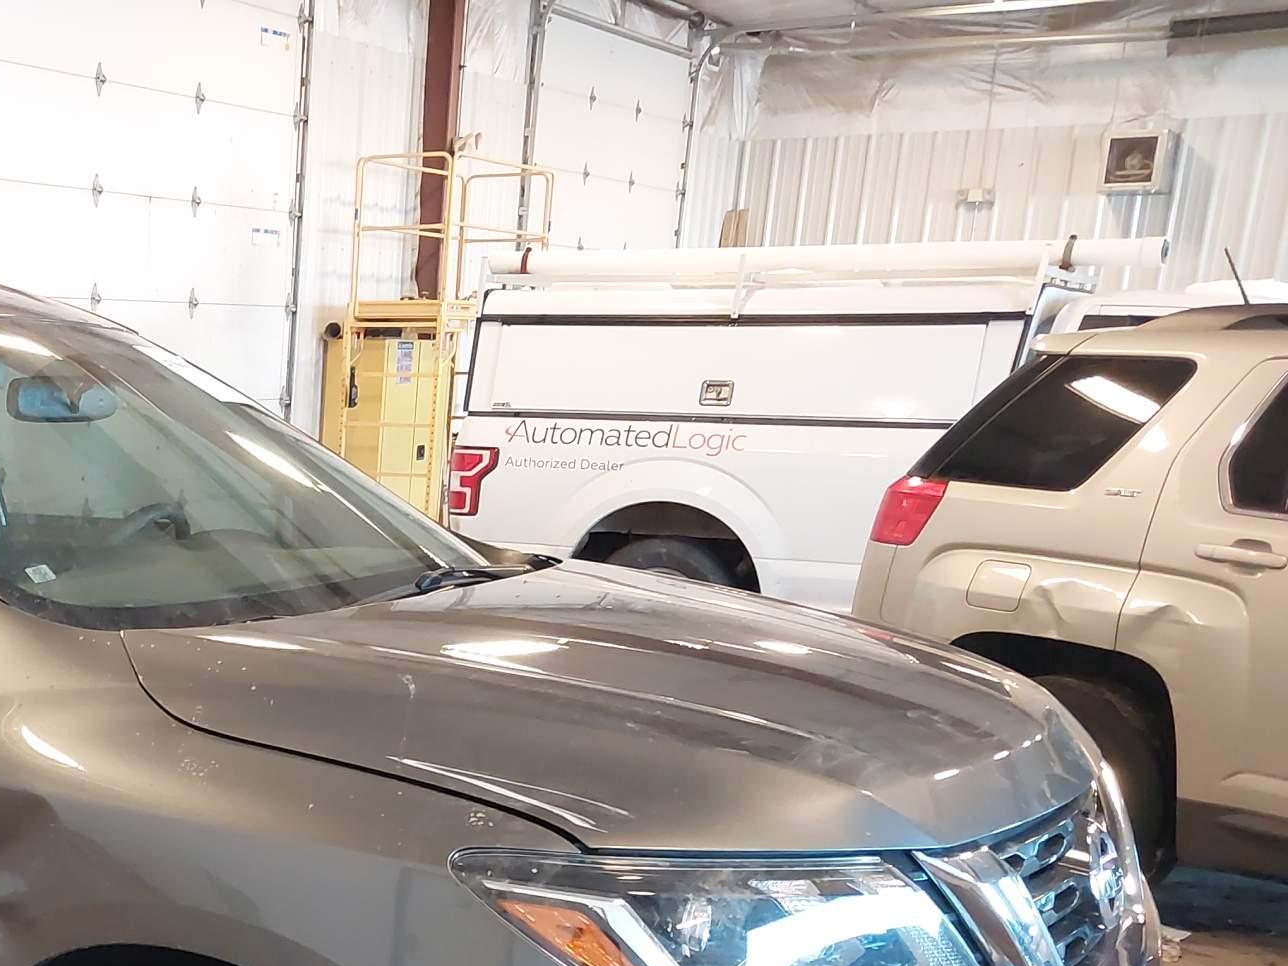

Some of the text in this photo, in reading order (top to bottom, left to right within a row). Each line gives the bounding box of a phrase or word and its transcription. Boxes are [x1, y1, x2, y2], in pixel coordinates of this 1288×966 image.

[505, 419, 748, 456] AutomatedLogic
[504, 456, 625, 471] Authorized Dealer
